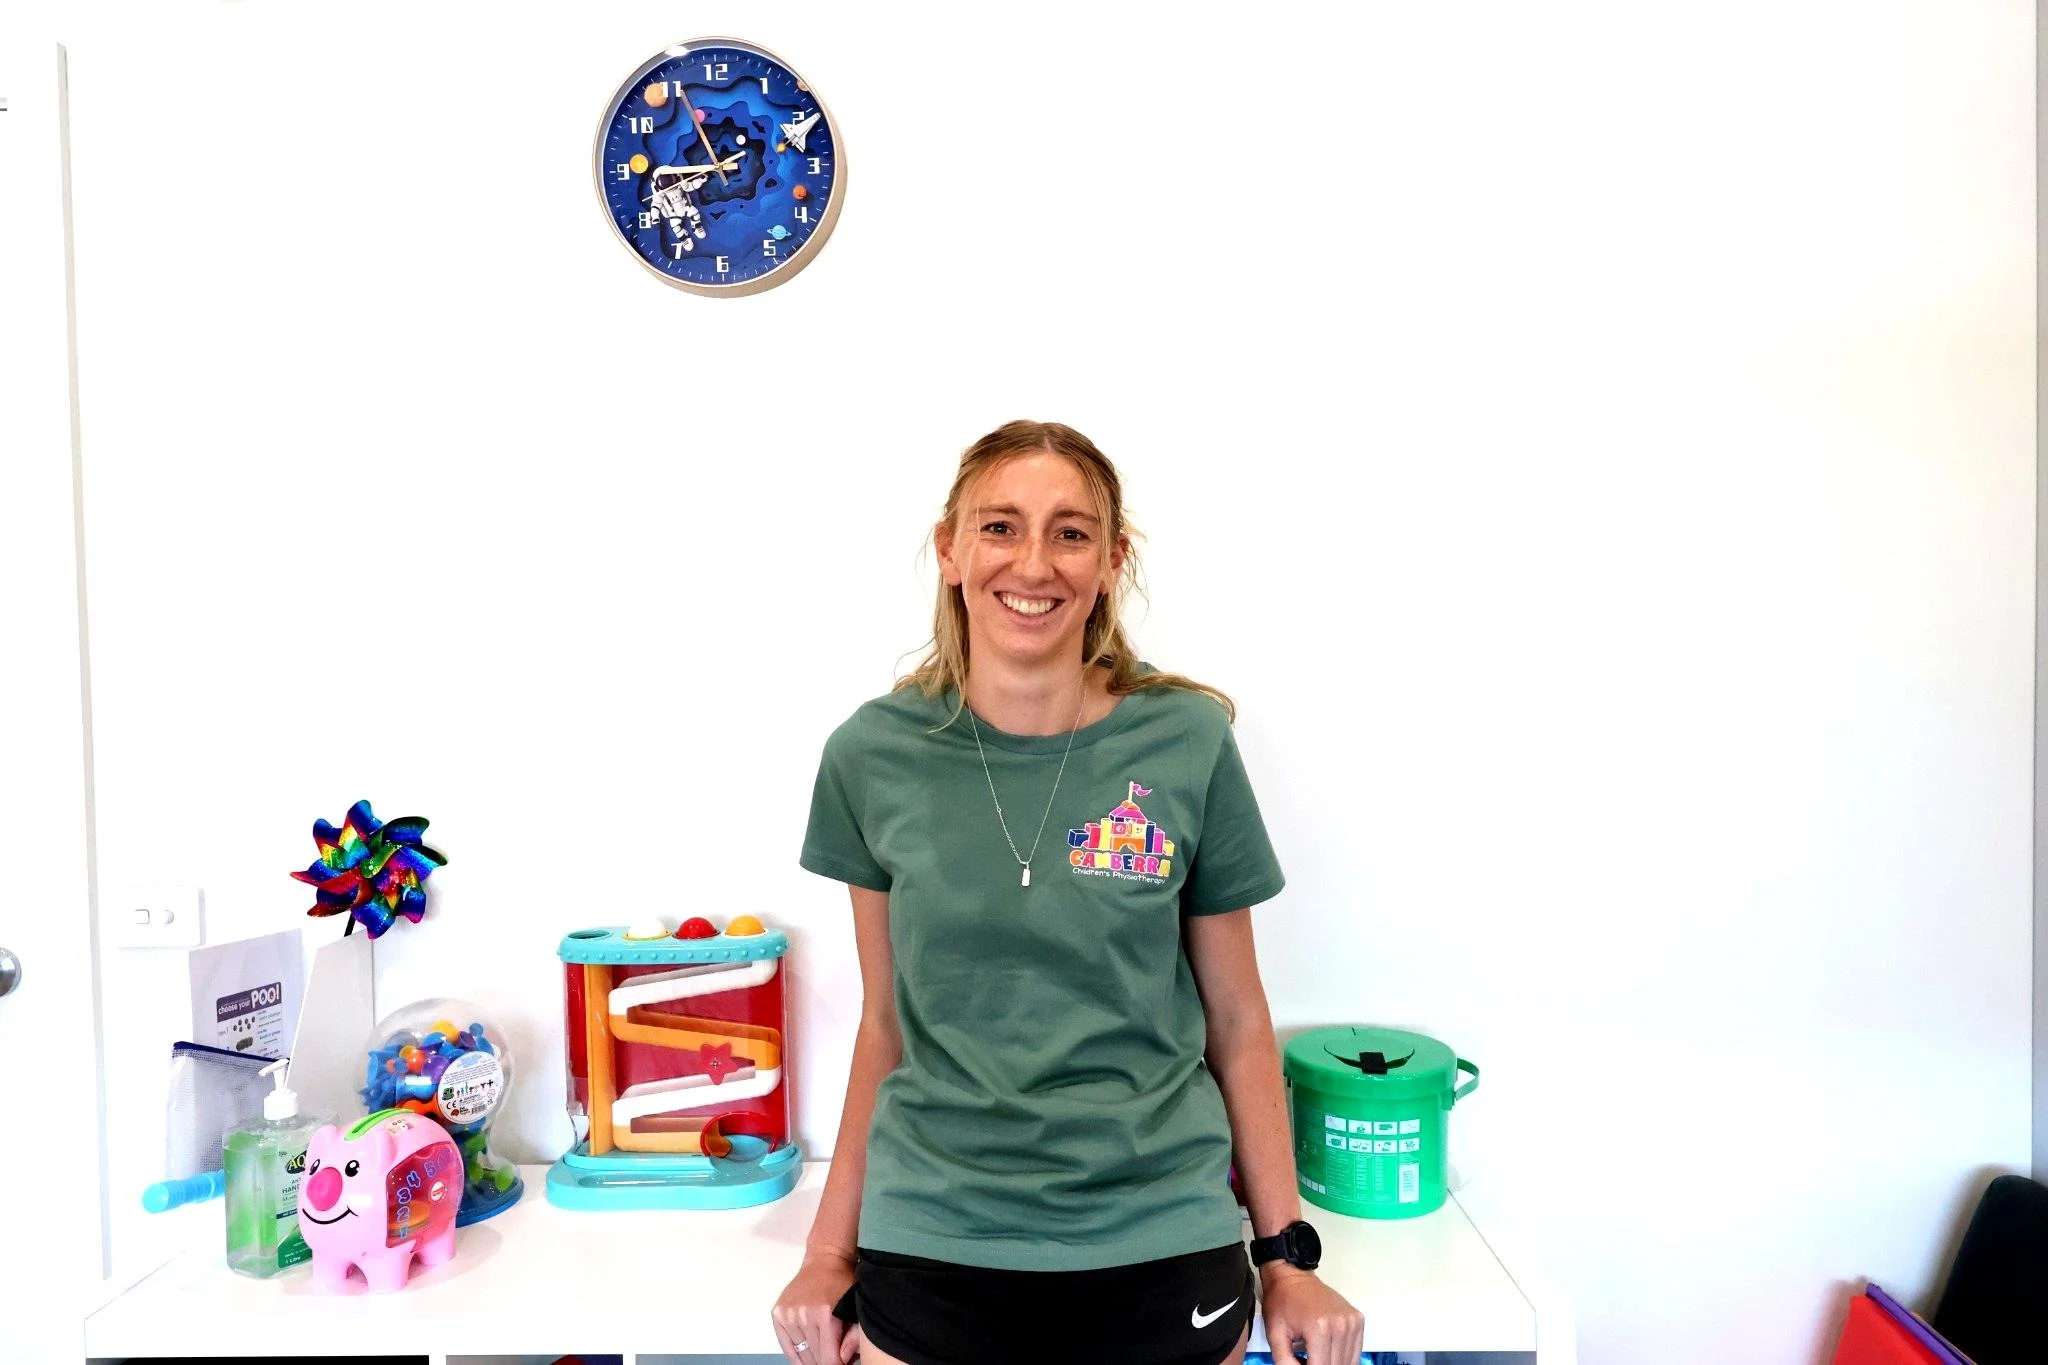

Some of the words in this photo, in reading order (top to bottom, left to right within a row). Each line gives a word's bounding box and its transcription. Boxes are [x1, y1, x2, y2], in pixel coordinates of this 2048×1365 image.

[704, 63, 728, 80] 12
[660, 81, 681, 98] 11
[760, 77, 768, 94] 1
[629, 116, 653, 134] 10
[616, 164, 630, 181] 9
[807, 157, 821, 175] 3
[639, 211, 652, 228] 8
[794, 206, 808, 223] 4
[671, 242, 683, 260] 7
[763, 239, 776, 257] 5
[716, 255, 729, 273] 6
[1072, 867, 1111, 877] Children's
[1112, 871, 1166, 885] Physiotherapy
[218, 1002, 238, 1015] choose
[238, 999, 251, 1011] your
[250, 983, 280, 1009] POO!
